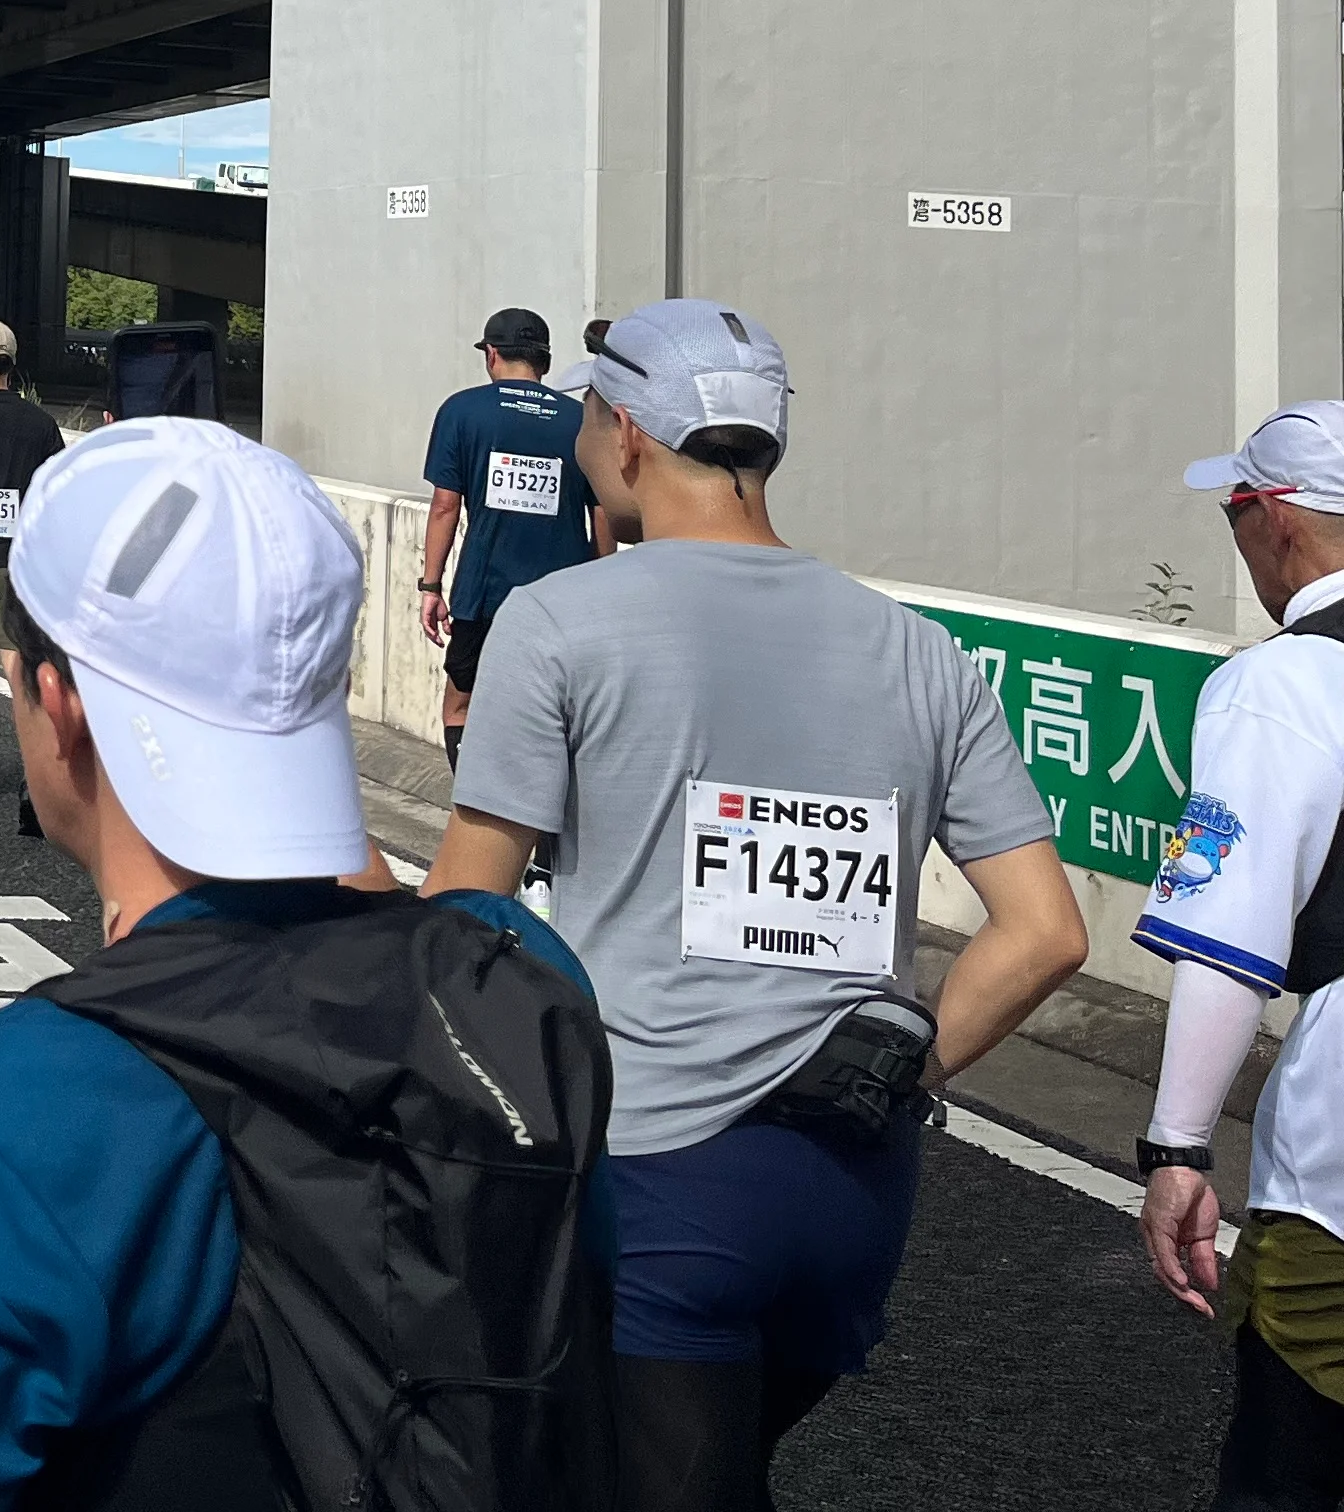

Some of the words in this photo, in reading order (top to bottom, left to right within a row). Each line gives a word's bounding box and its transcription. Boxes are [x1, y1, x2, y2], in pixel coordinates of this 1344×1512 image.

[511, 457, 552, 471] ENEOS
[492, 469, 558, 494] G15273
[498, 497, 548, 510] NISSAN
[749, 795, 869, 833] ENEOS
[695, 833, 892, 908] F14374
[743, 925, 816, 957] PUMA
[427, 990, 534, 1146] LOMON
